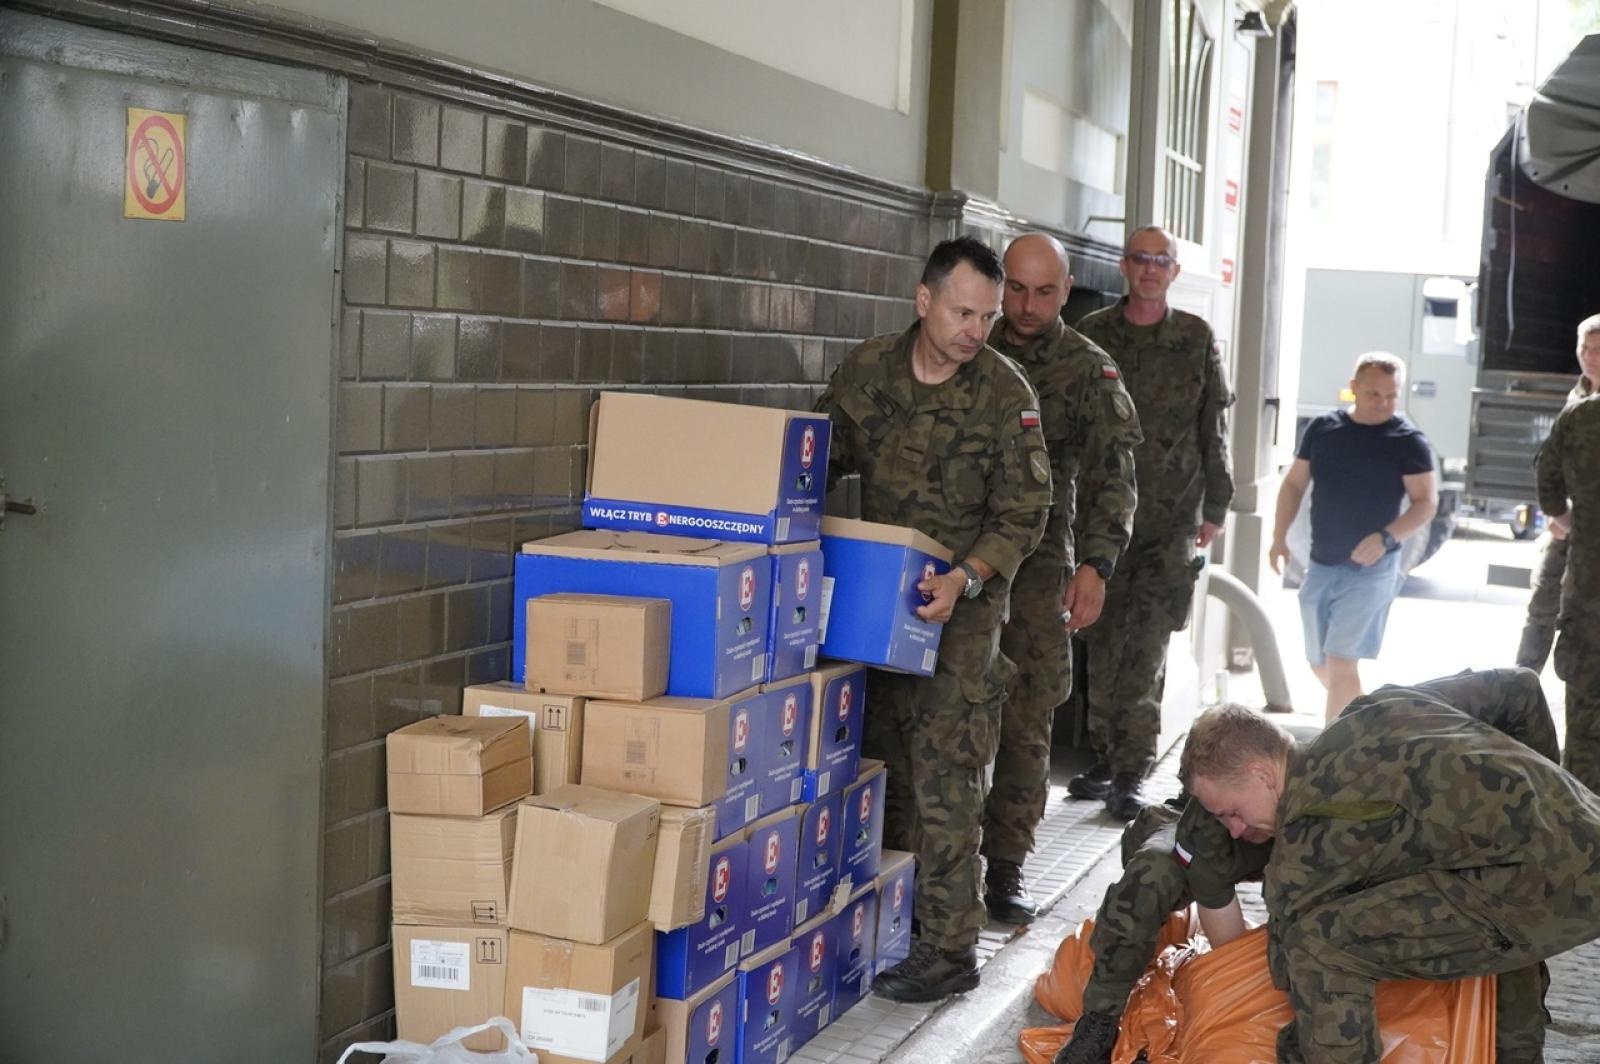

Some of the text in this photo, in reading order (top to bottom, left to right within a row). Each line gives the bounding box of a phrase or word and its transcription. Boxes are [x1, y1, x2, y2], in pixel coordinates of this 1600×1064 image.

[590, 507, 764, 535] WŁĄCZ TRYB ENERGOOSZCZĘDNY
